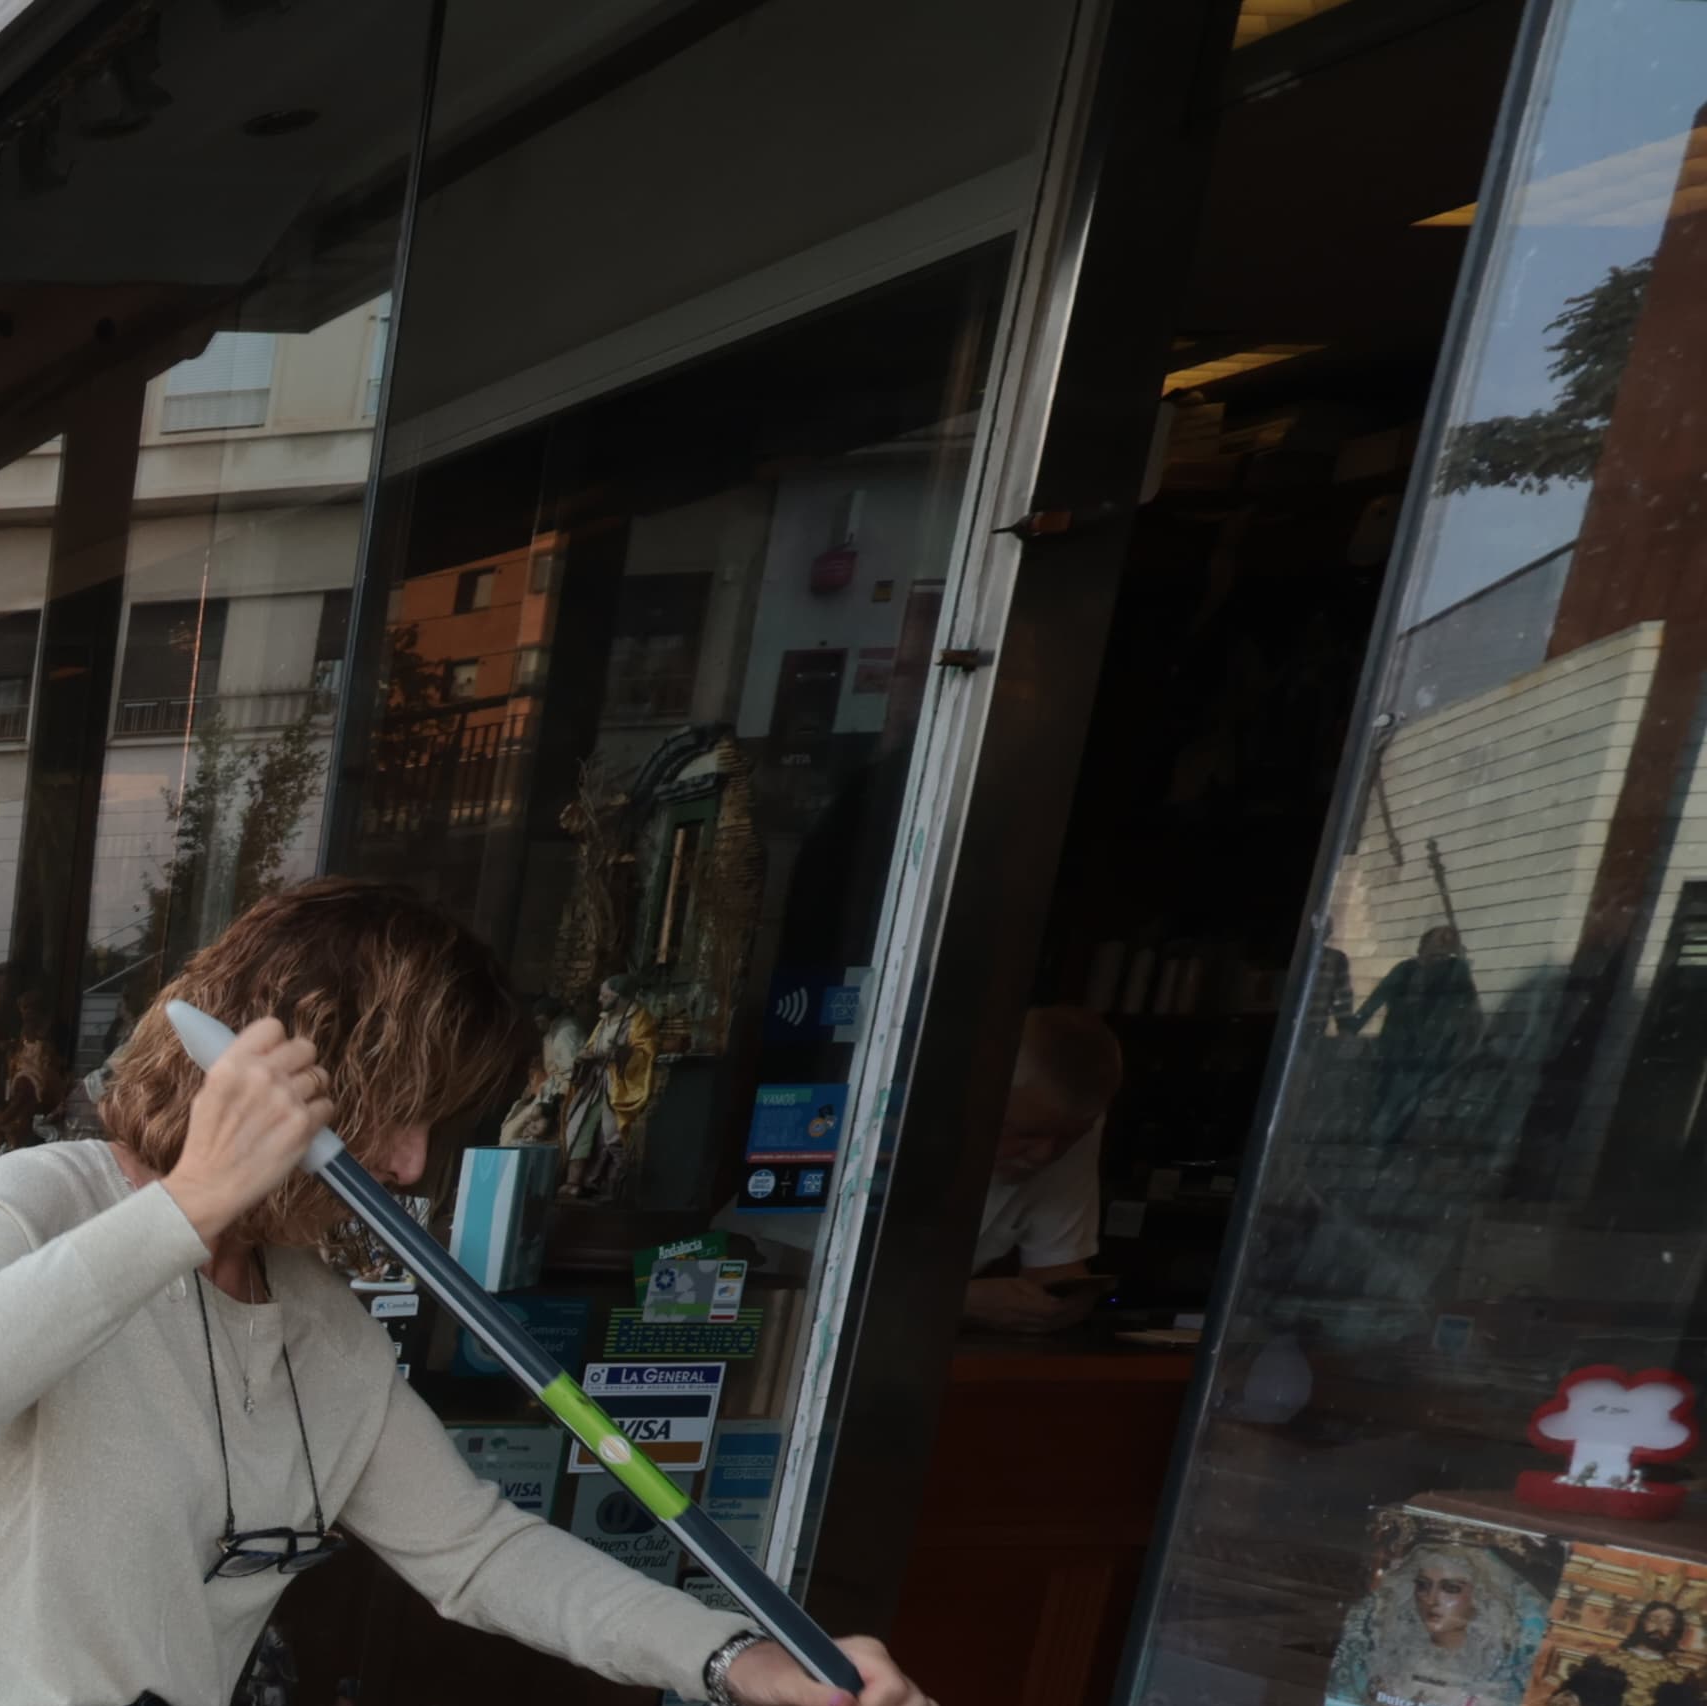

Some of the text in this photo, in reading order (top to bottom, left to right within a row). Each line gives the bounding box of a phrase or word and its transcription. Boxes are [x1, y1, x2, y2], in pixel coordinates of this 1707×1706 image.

[620, 1367, 706, 1384] LA GENERAL
[619, 1420, 671, 1440] VISA
[504, 1482, 542, 1497] VISA
[633, 1535, 670, 1552] Club
